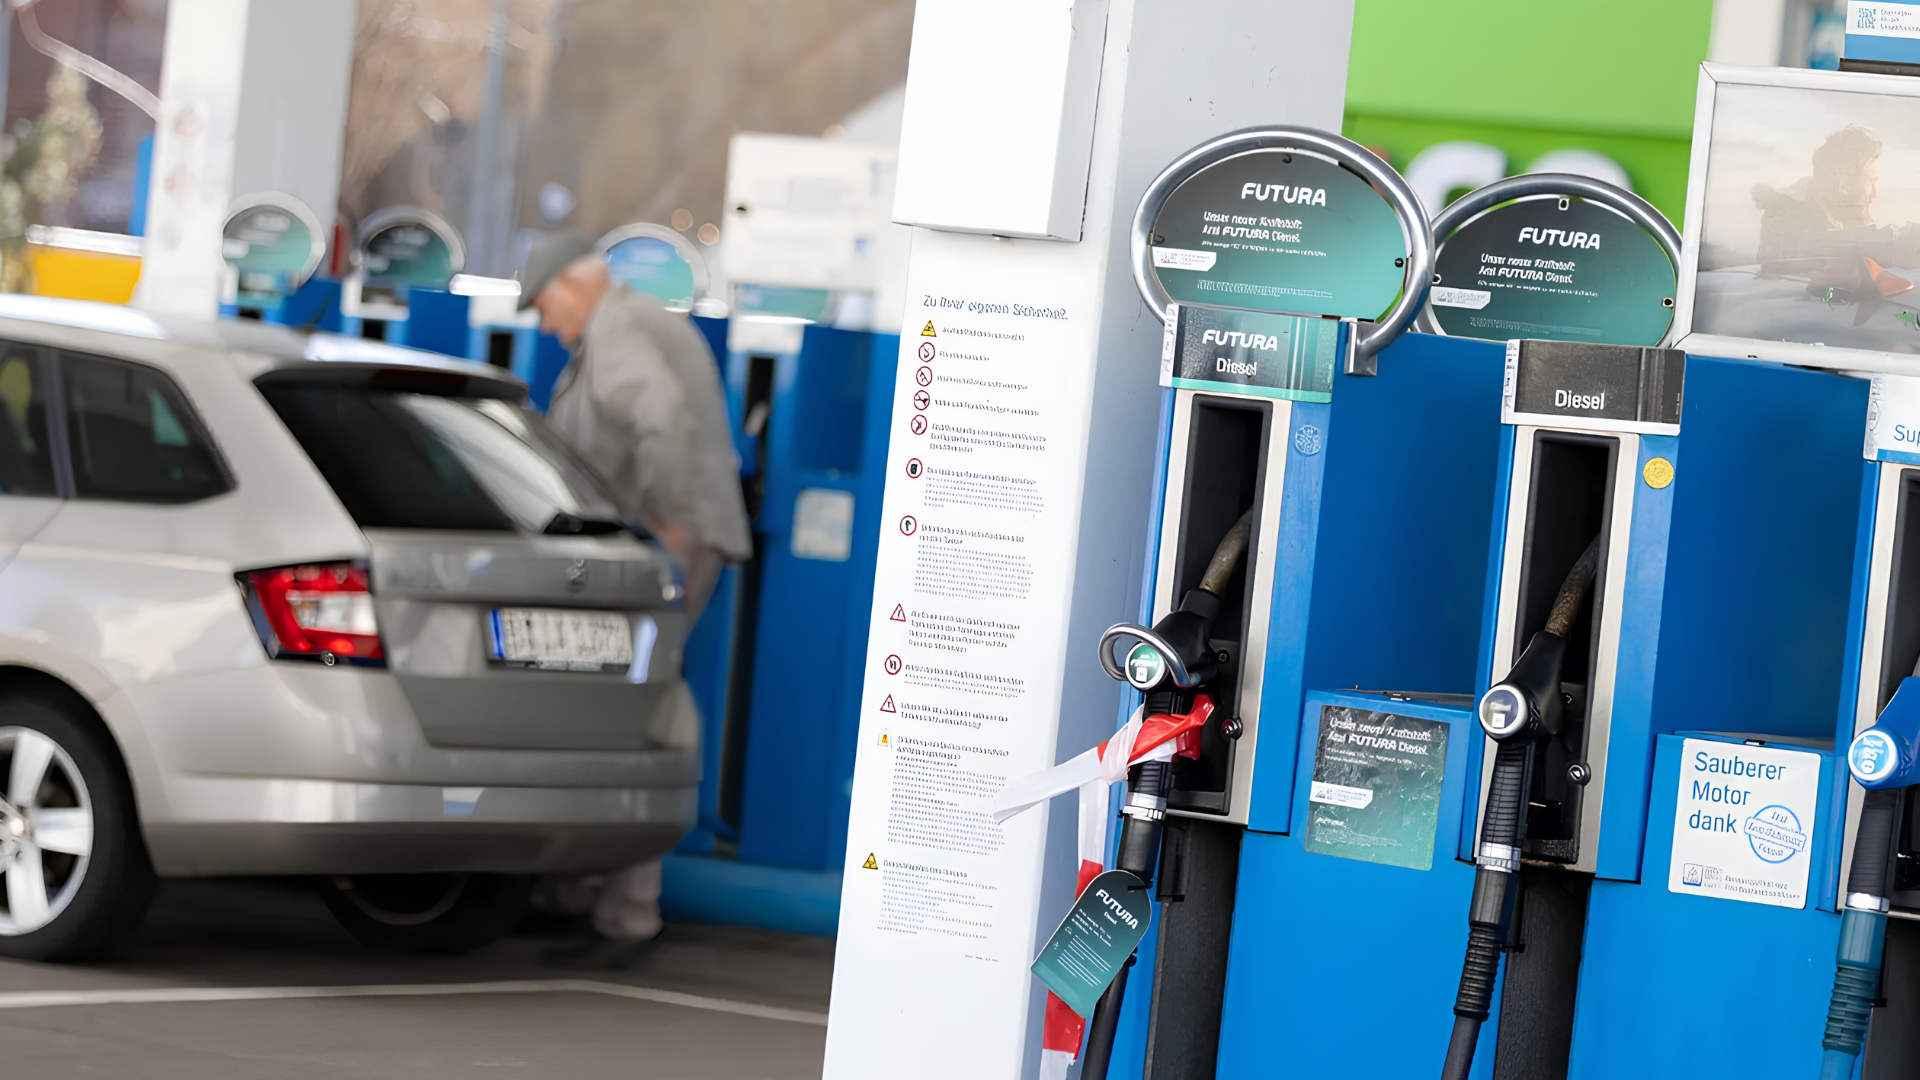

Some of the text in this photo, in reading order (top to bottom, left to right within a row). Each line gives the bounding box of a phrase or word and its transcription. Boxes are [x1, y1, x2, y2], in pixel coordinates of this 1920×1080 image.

[1241, 182, 1326, 207] FUTURA
[1518, 226, 1601, 250] FUTURA
[1202, 329, 1278, 351] FUTURA
[1216, 358, 1257, 375] Diesel
[1555, 389, 1605, 410] Diesel
[1348, 733, 1397, 750] FUTURA
[1694, 751, 1786, 780] Sauberer
[1692, 780, 1751, 806] Motor
[1688, 809, 1737, 834] dank
[1095, 888, 1139, 930] FUTURA
